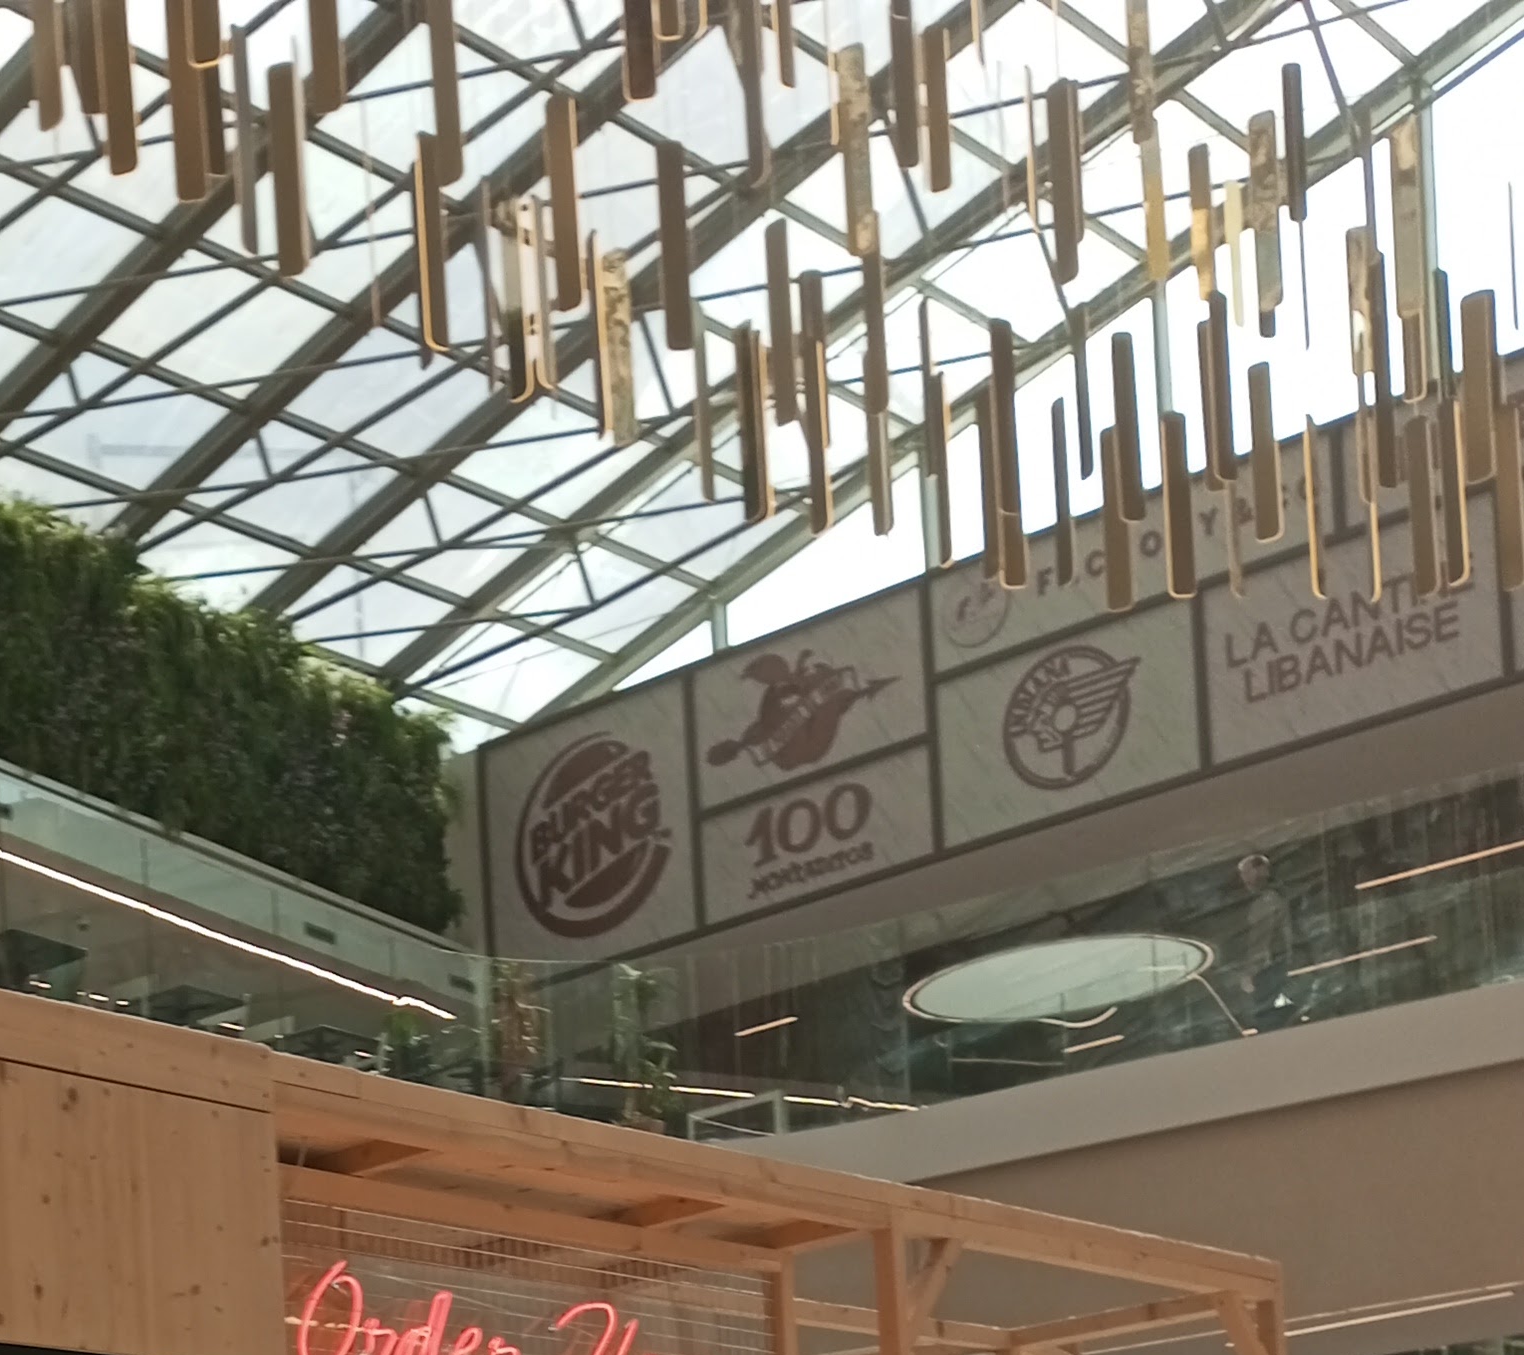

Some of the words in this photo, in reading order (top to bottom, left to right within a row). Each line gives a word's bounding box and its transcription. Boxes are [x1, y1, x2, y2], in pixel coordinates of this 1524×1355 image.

[1226, 620, 1279, 668] LA
[1289, 551, 1474, 645] CANTIE
[1242, 601, 1461, 703] LIBANAISE
[531, 750, 654, 865] BURGER
[539, 781, 662, 908] KING
[743, 781, 873, 868] 100
